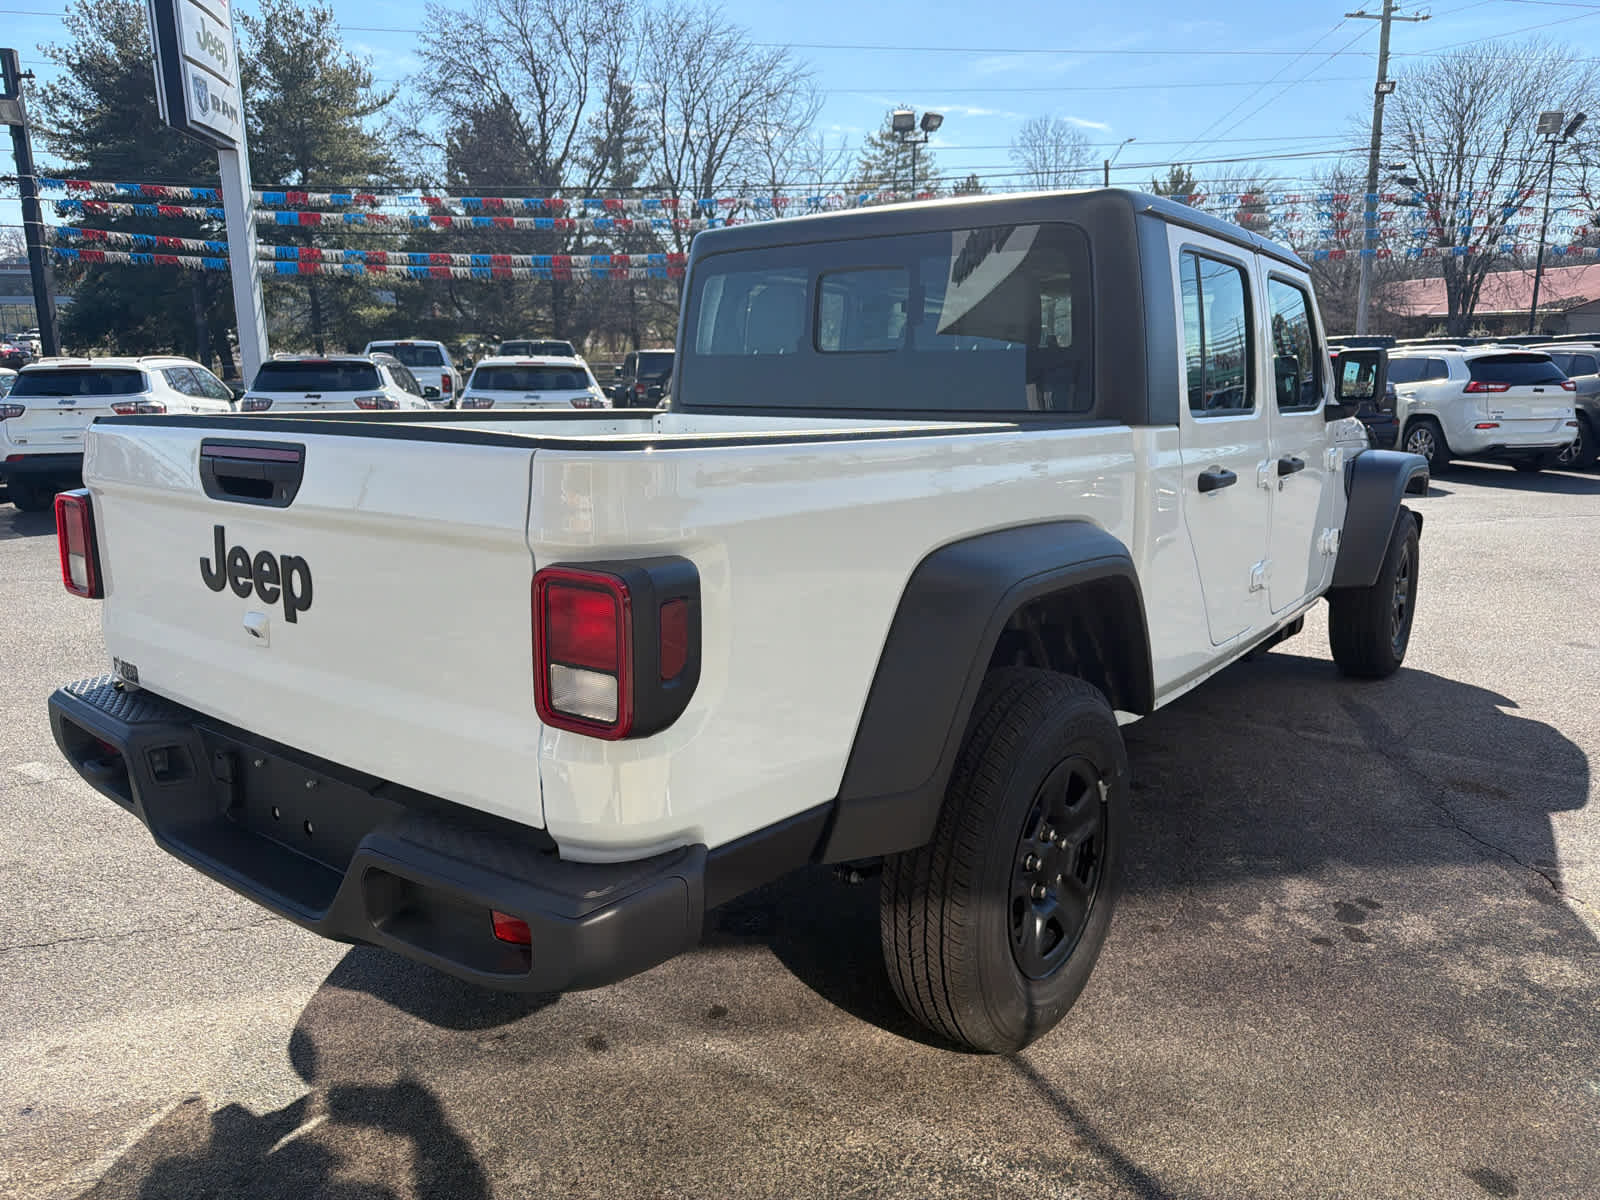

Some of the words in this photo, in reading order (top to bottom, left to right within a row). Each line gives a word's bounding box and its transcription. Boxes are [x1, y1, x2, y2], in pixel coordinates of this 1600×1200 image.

[196, 17, 228, 72] Jeep
[210, 92, 239, 125] RAM
[199, 524, 313, 624] Jeep
